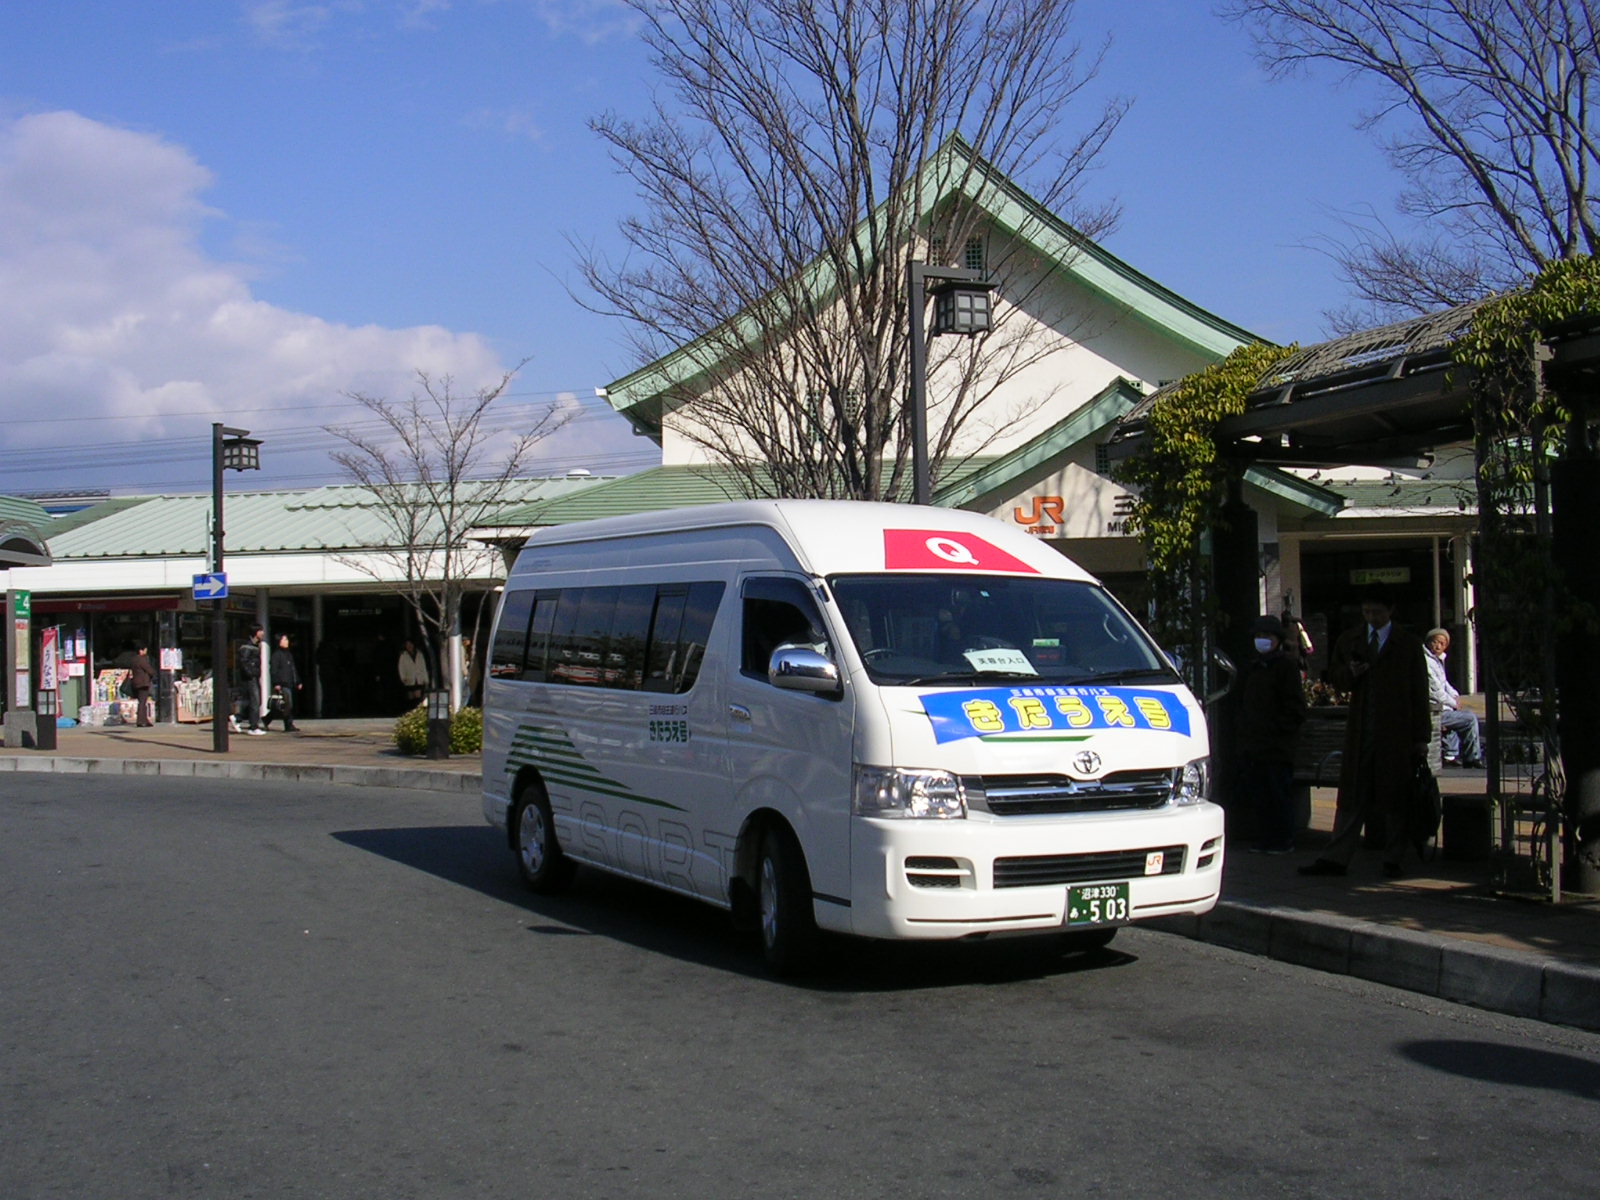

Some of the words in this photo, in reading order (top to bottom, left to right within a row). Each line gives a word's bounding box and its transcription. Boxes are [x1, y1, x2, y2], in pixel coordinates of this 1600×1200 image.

[1013, 496, 1065, 525] JR
[925, 537, 980, 566] Q
[22, 595, 30, 609] 4
[961, 695, 1172, 733] きたうえ号
[649, 720, 688, 743] きたうえ号
[1147, 855, 1162, 866] JR
